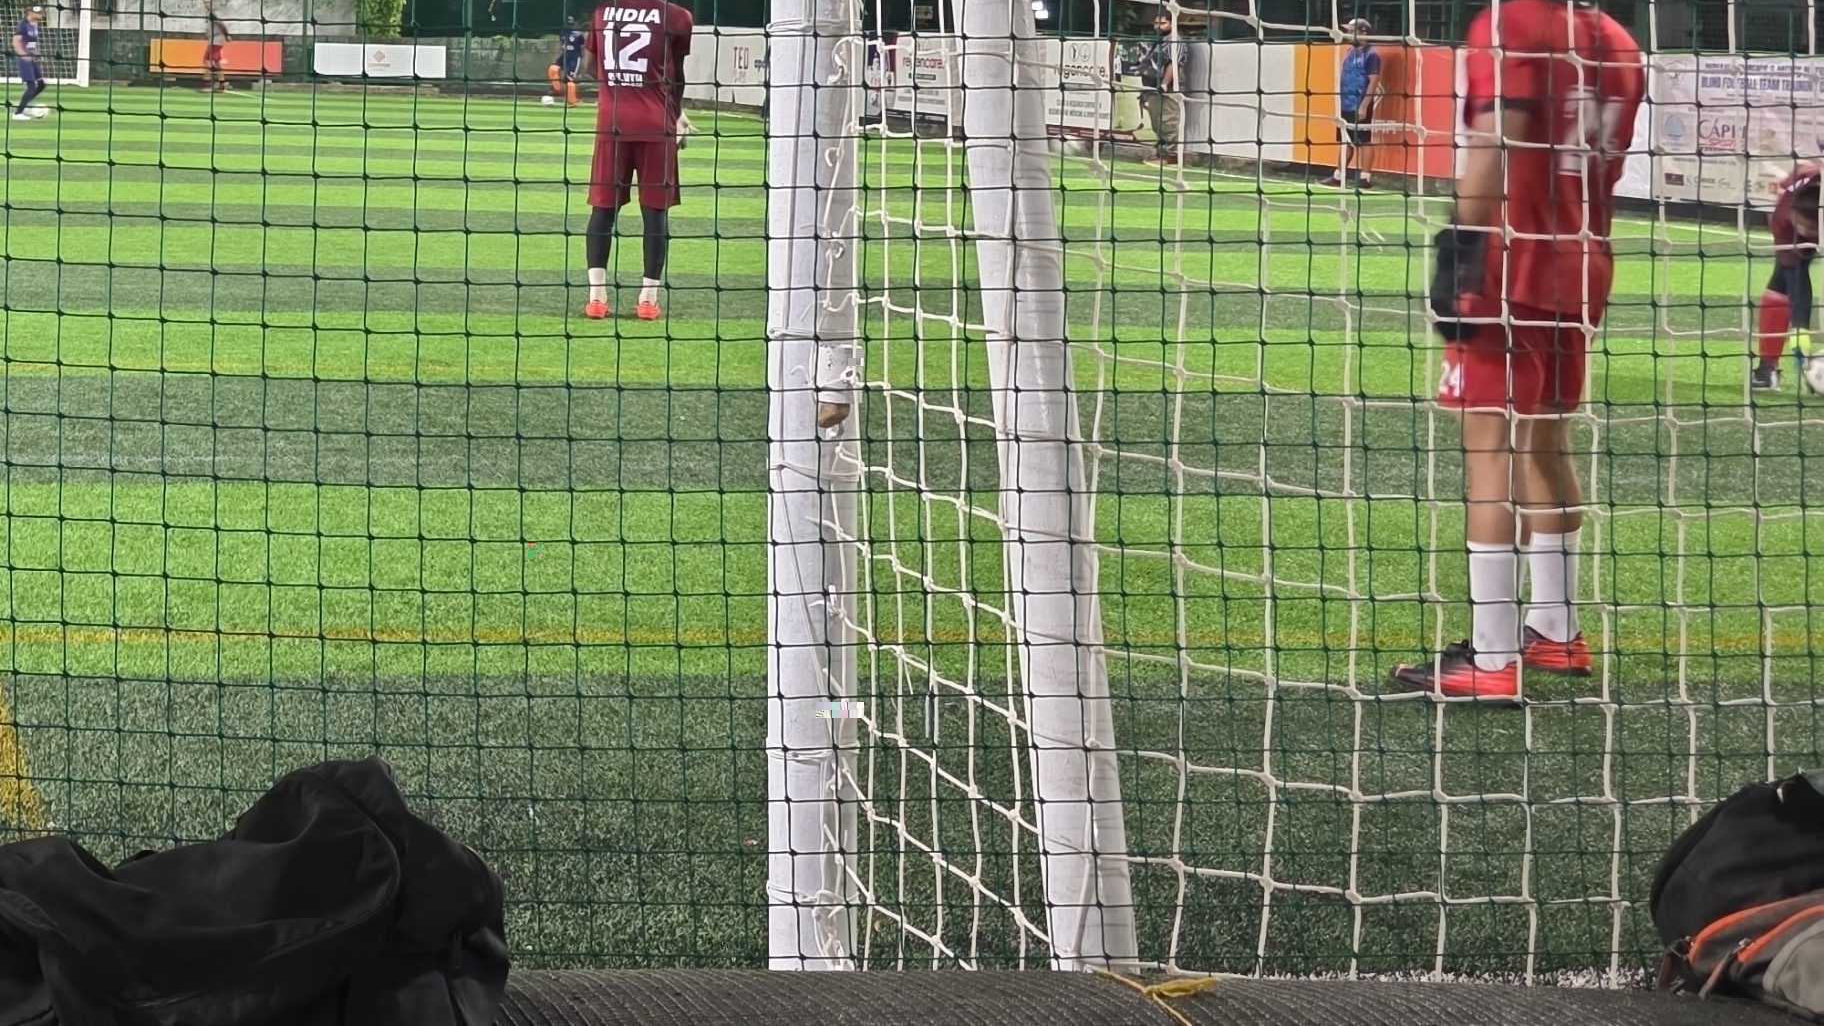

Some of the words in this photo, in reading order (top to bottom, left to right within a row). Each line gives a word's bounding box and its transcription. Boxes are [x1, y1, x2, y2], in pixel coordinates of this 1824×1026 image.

[603, 7, 661, 24] INDIA
[603, 21, 651, 73] 12
[1759, 78, 1780, 92] TEAM
[1438, 360, 1465, 398] 24
